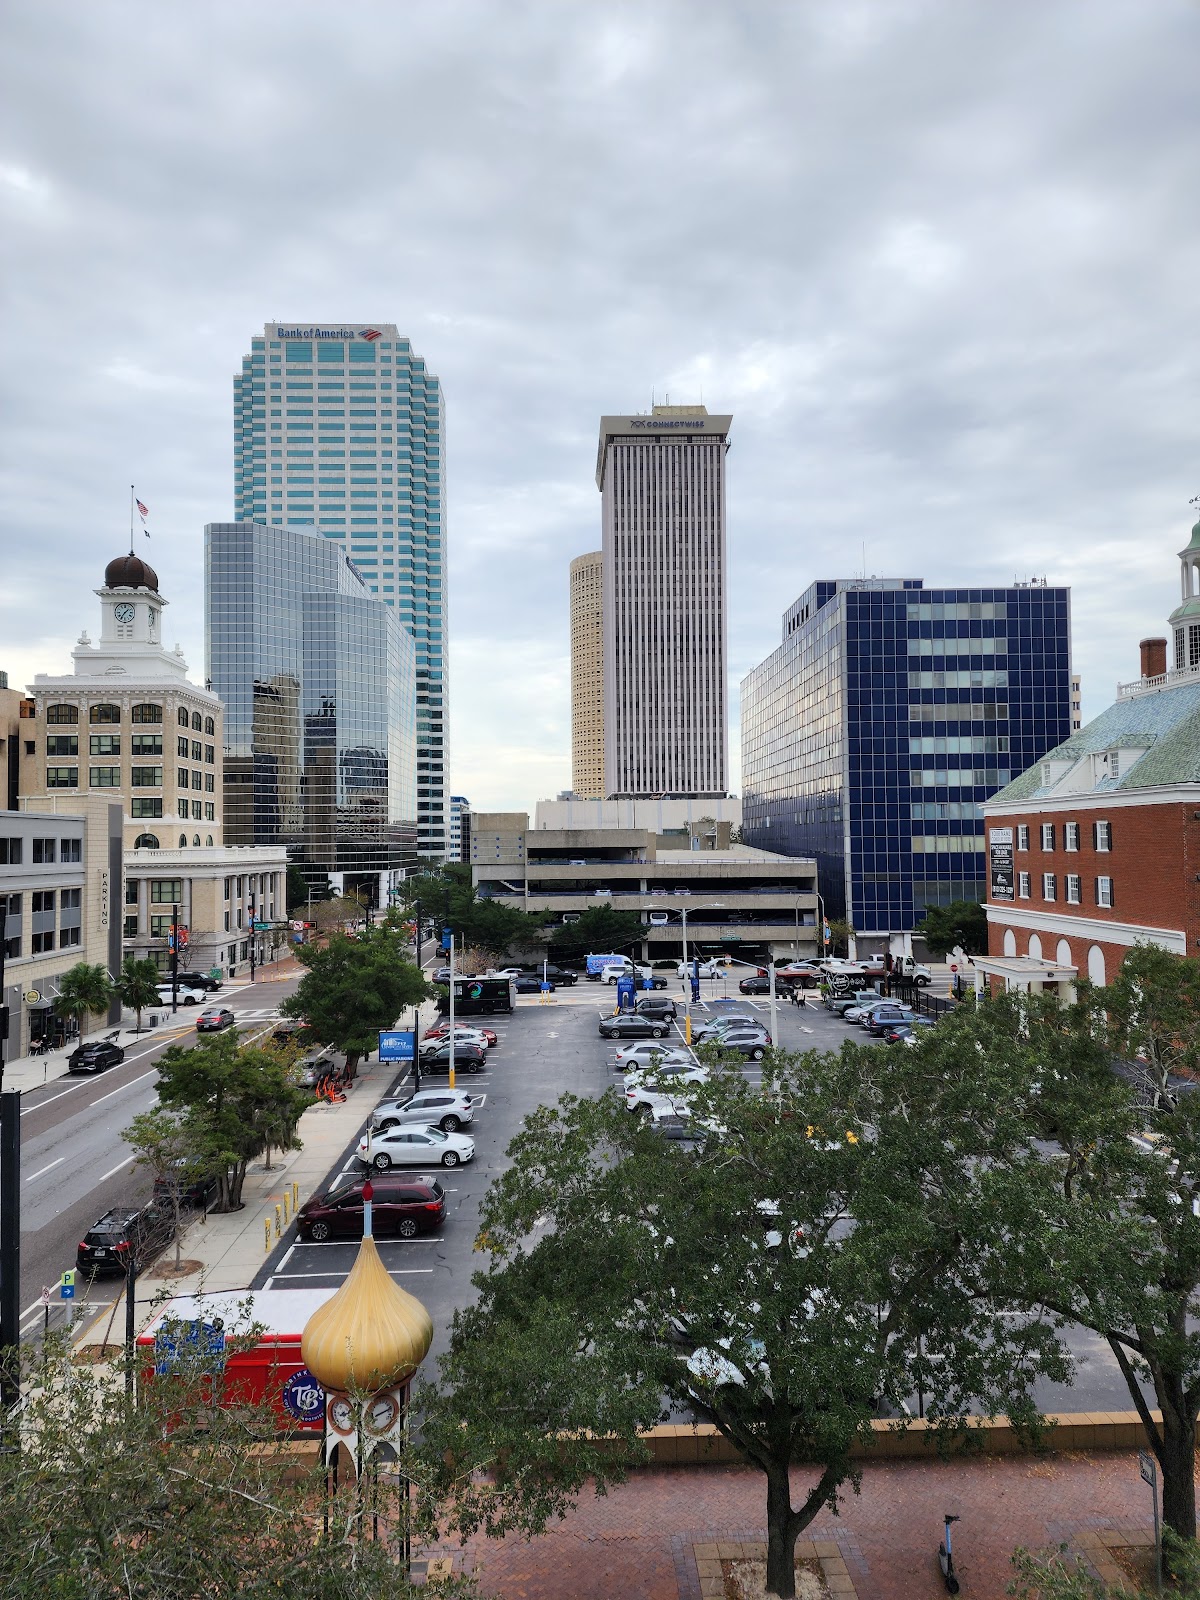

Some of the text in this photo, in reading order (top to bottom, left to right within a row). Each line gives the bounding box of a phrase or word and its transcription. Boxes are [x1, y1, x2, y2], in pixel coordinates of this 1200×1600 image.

[277, 327, 355, 339] Bank of America
[646, 420, 705, 429] CONNECTWISE
[64, 1274, 71, 1285] P
